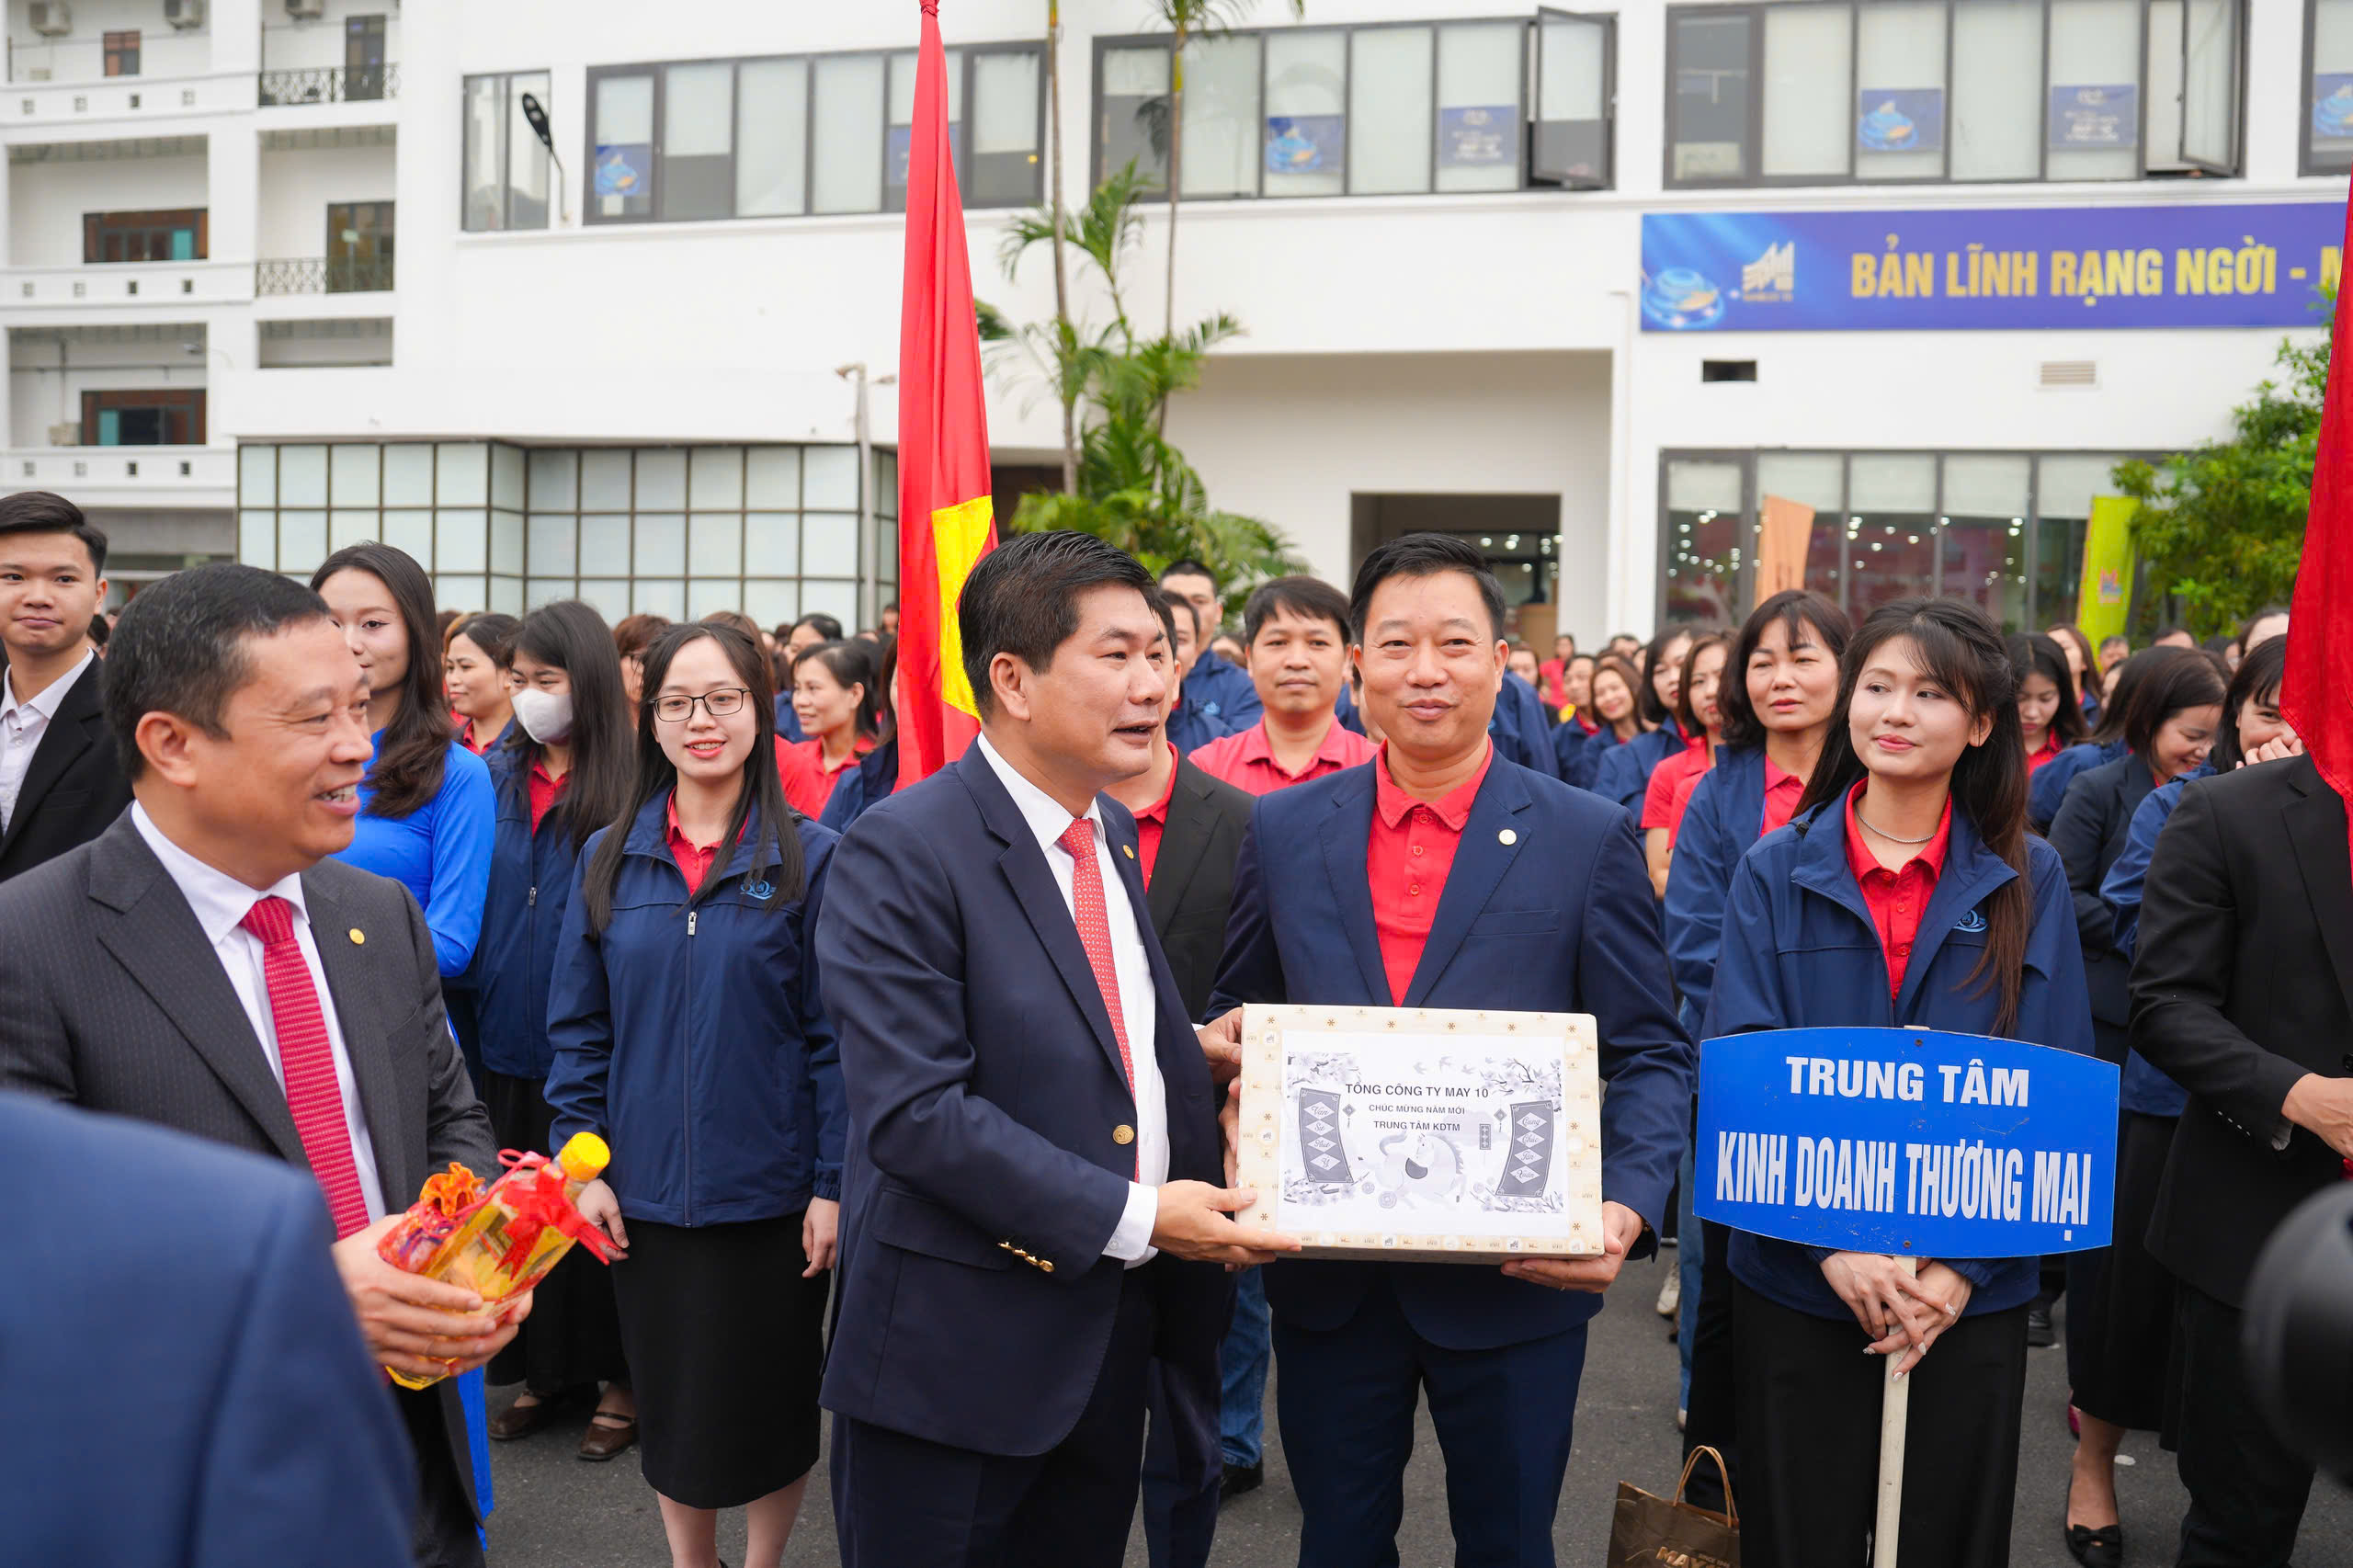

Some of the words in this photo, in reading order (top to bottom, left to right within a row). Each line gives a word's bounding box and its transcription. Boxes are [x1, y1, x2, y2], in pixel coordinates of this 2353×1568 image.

[1850, 233, 1934, 298] BẢN
[1945, 242, 2038, 298] LĨNH
[2050, 248, 2163, 306] RẠNG
[2175, 234, 2277, 295] NGỜI
[1385, 1083, 1423, 1096] CÔNG
[1427, 1086, 1441, 1096] TY
[1446, 1087, 1471, 1097] MAY
[1475, 1088, 1489, 1098] 10
[1785, 1055, 1924, 1102] TRUNG
[1938, 1058, 2029, 1108] TÂM
[1369, 1104, 1393, 1112] CHÚC
[1396, 1104, 1424, 1113] MỪNG
[1426, 1105, 1446, 1114] NĂM
[1448, 1106, 1465, 1115] MỚI
[1373, 1120, 1407, 1130] TRUNG
[1410, 1119, 1430, 1131] TÂM
[1715, 1131, 1788, 1205] KINH
[1795, 1136, 1897, 1213] DOANH
[1905, 1138, 2023, 1222] THƯƠNG
[2031, 1151, 2091, 1241] MẠI
